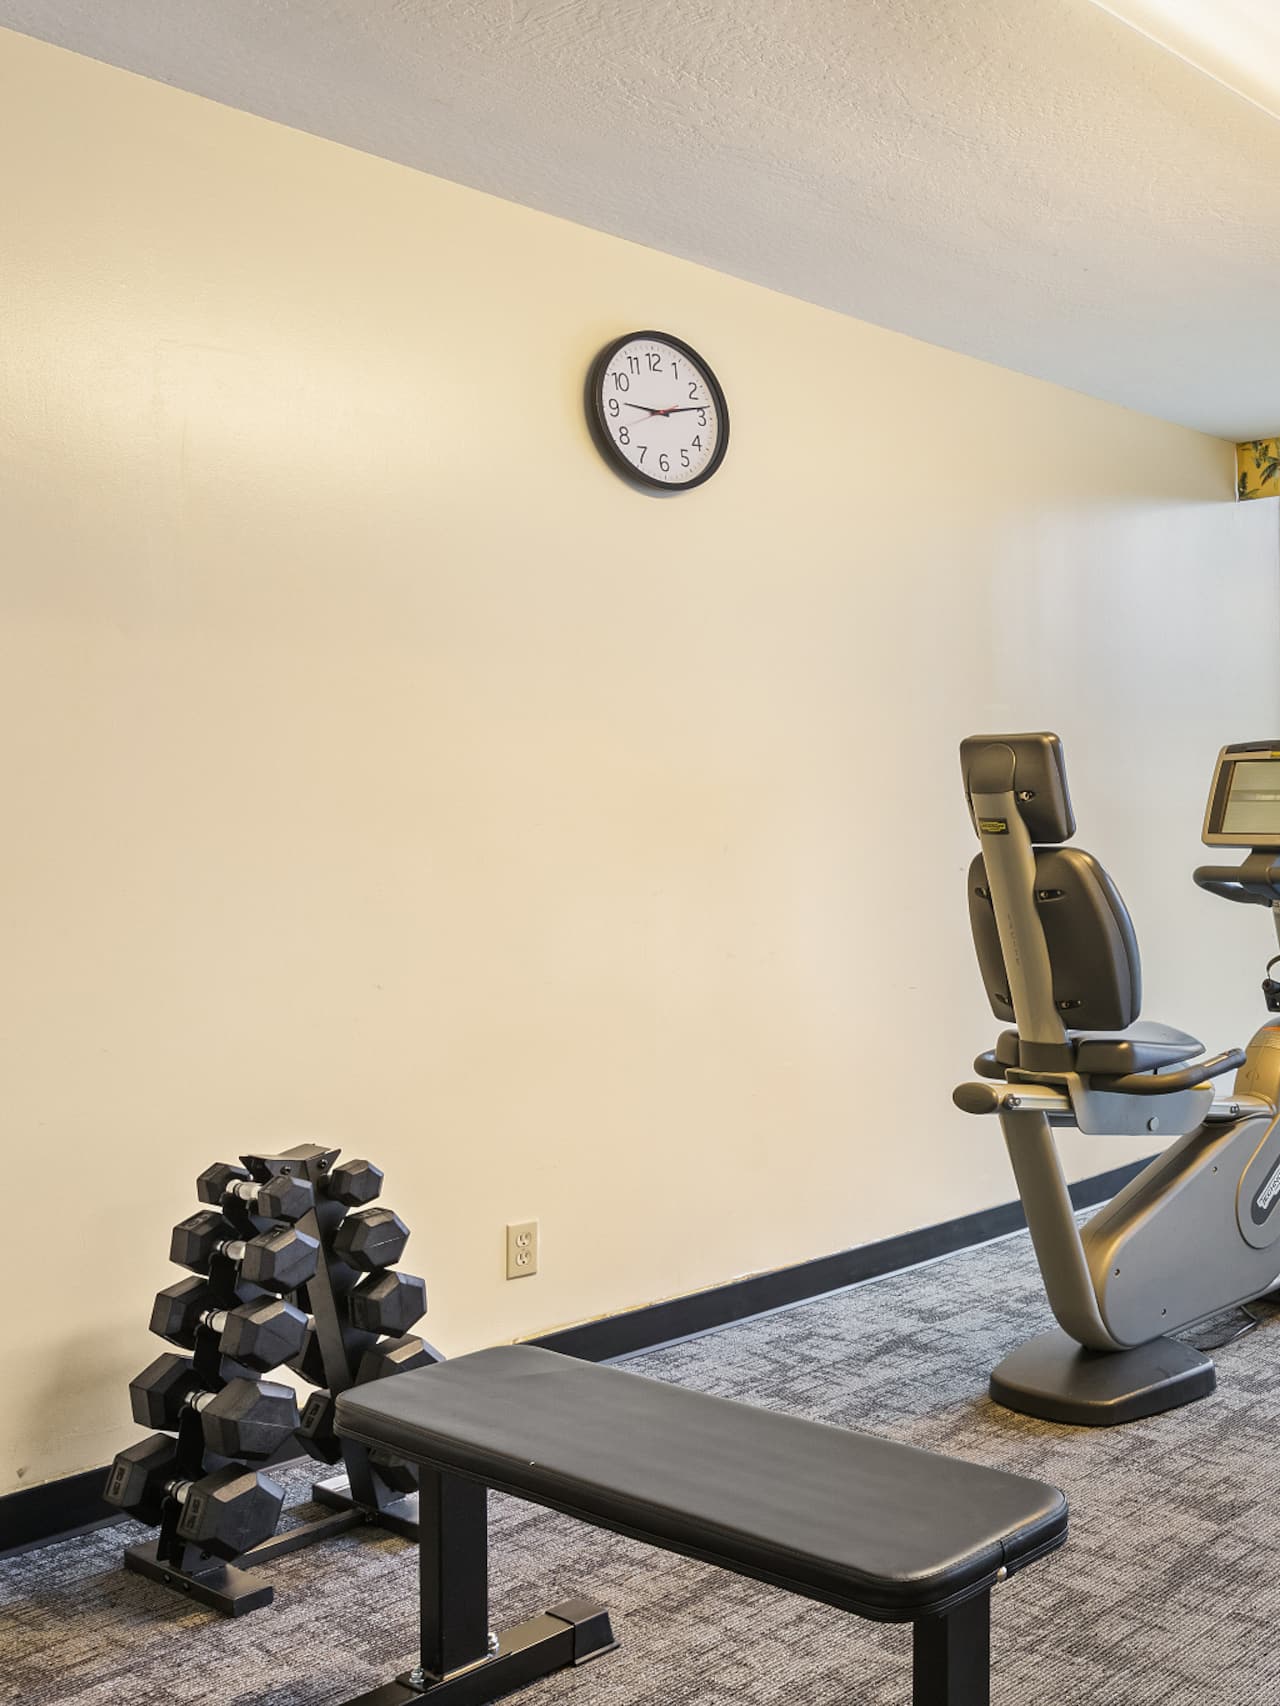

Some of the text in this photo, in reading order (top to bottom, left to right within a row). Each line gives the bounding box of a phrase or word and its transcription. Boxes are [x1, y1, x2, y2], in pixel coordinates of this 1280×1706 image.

[627, 356, 640, 375] 11
[645, 353, 663, 372] 12
[672, 361, 679, 380] 1
[612, 372, 630, 392] 10
[688, 382, 698, 400] 2
[608, 398, 620, 418] 9
[697, 409, 707, 427] 3
[619, 426, 630, 445] 8
[691, 435, 703, 452] 4
[637, 446, 648, 464] 7
[659, 454, 670, 472] 6
[680, 449, 690, 467] 5
